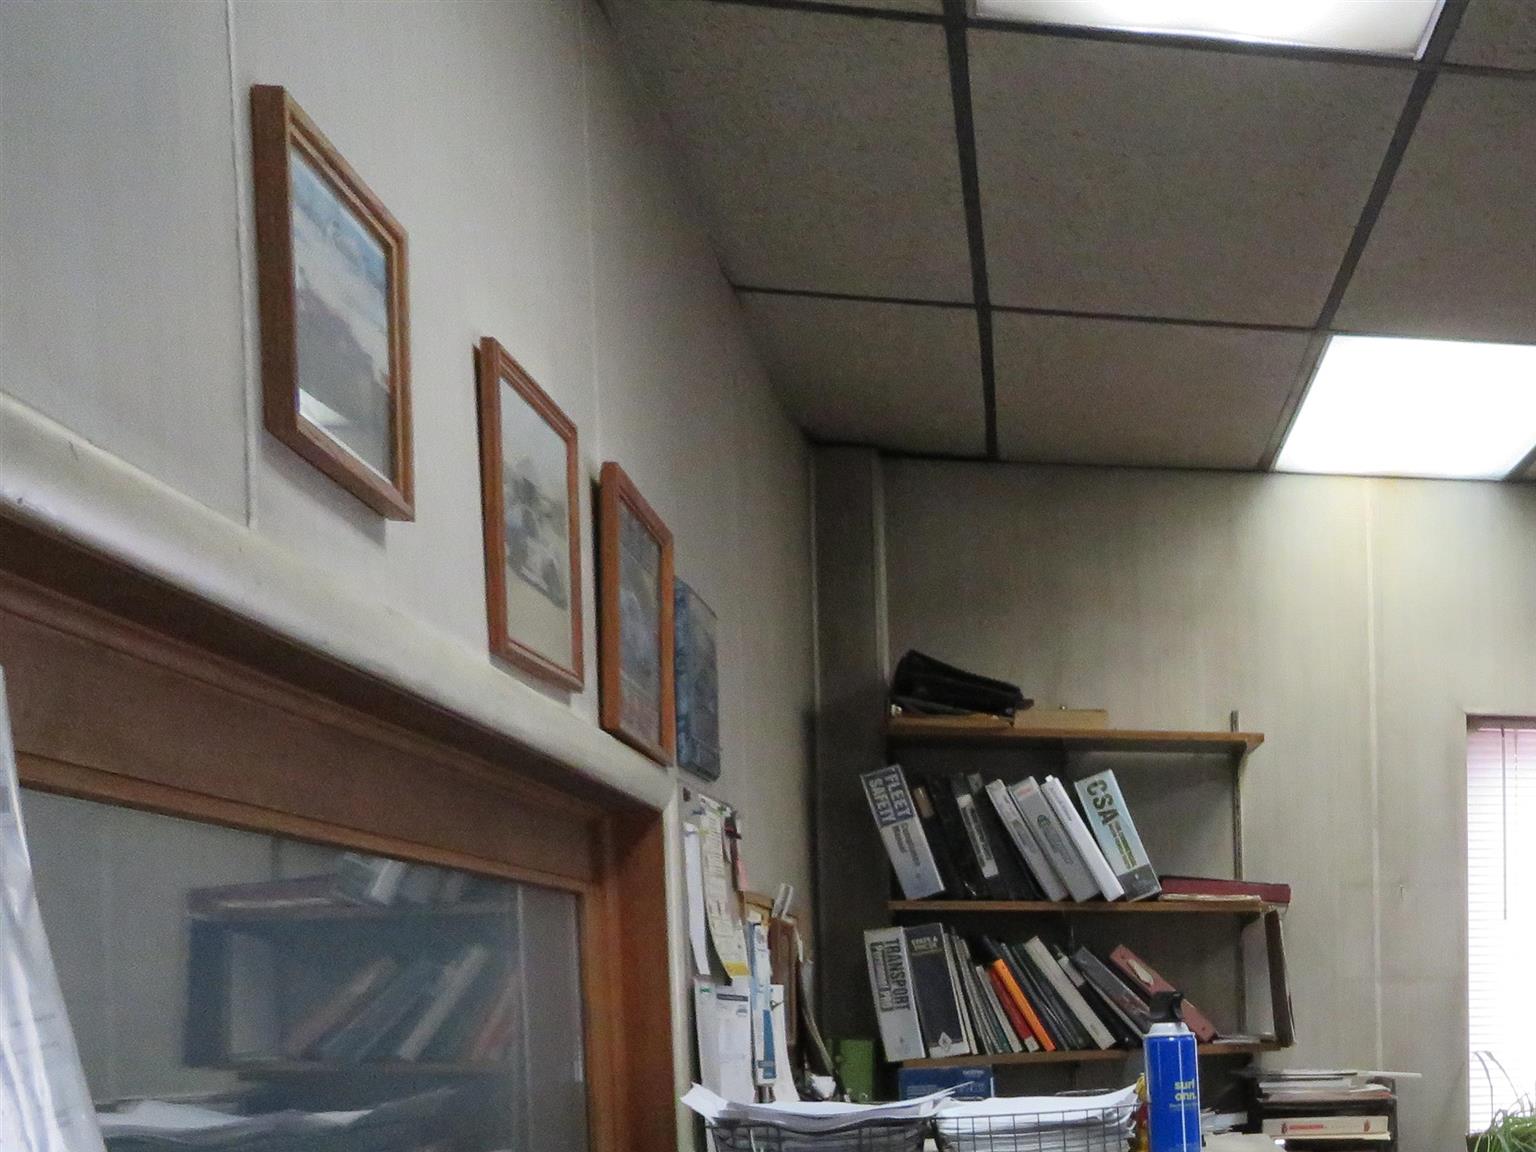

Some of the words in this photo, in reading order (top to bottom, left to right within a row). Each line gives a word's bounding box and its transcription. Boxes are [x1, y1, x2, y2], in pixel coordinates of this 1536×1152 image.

[869, 778, 897, 821] SAFETY
[884, 774, 912, 817] FLEET
[1086, 779, 1120, 826] CSA
[884, 938, 911, 1010] TRANSPORT
